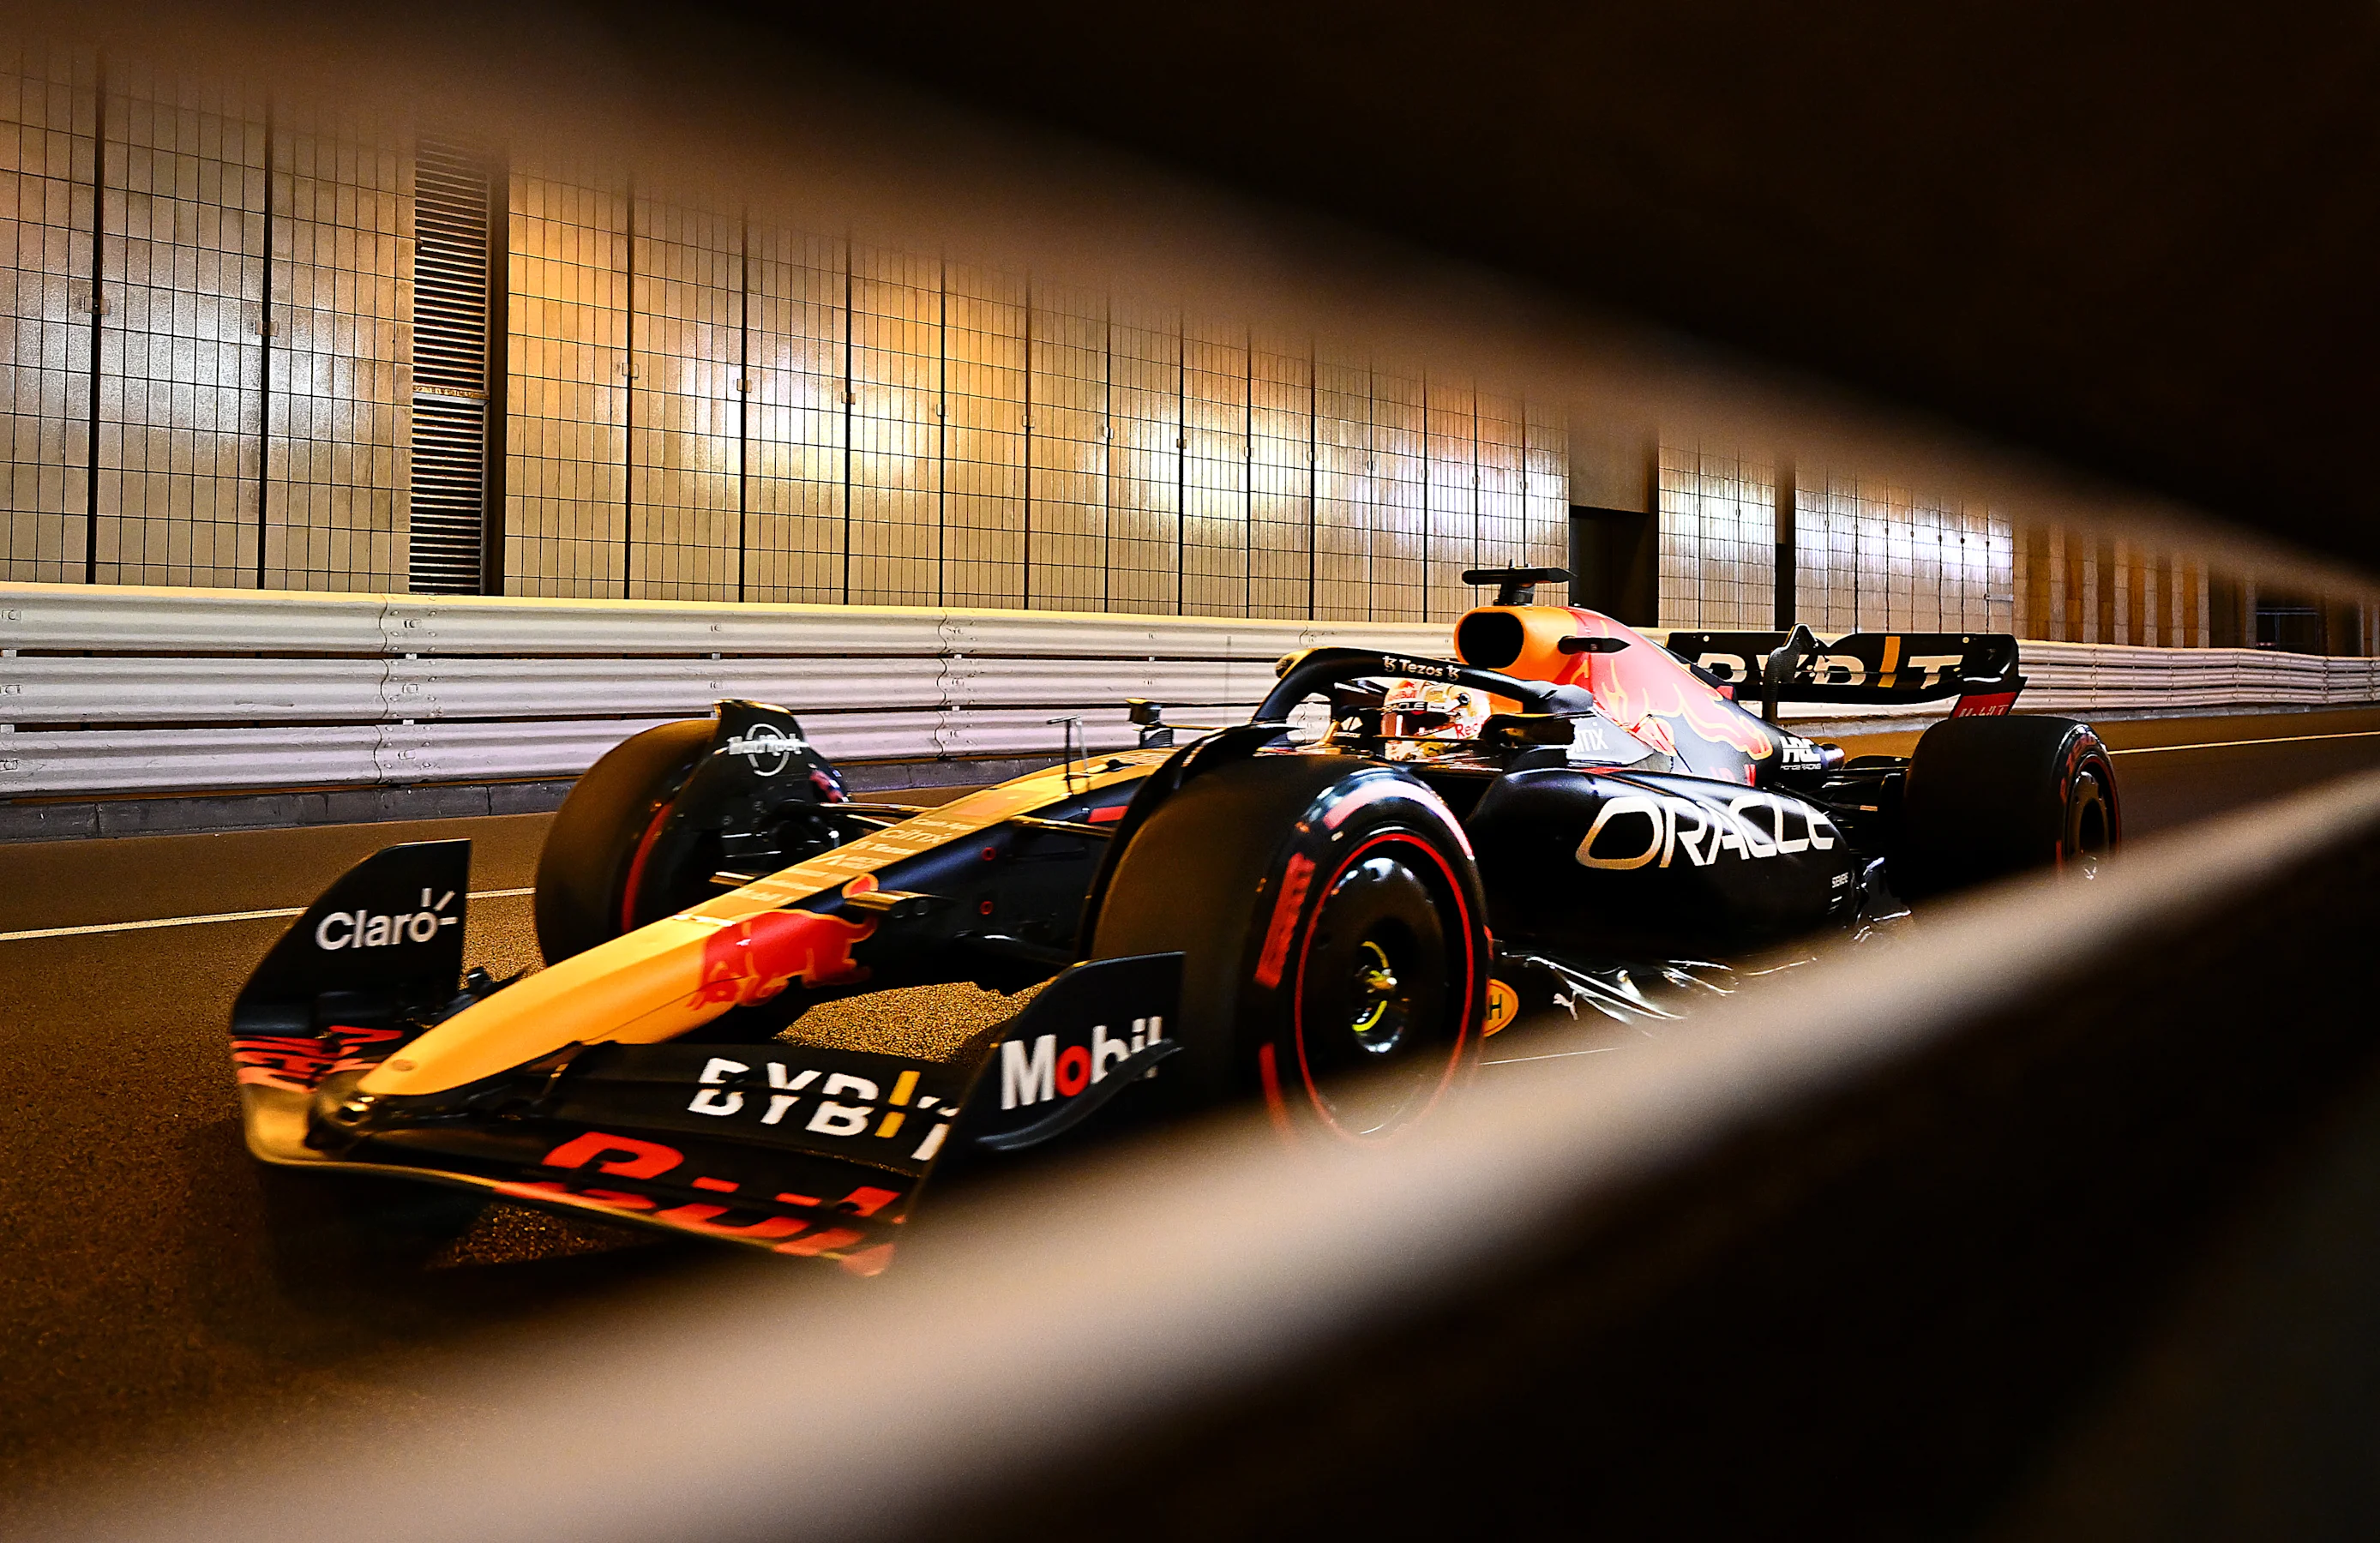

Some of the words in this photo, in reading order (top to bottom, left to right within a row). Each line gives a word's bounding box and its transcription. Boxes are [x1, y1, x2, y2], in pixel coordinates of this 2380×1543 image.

[1399, 658, 1444, 677] Tezos
[1576, 793, 1834, 869] ORACLE
[316, 905, 438, 951] Claro
[1001, 1016, 1163, 1110] Mobil
